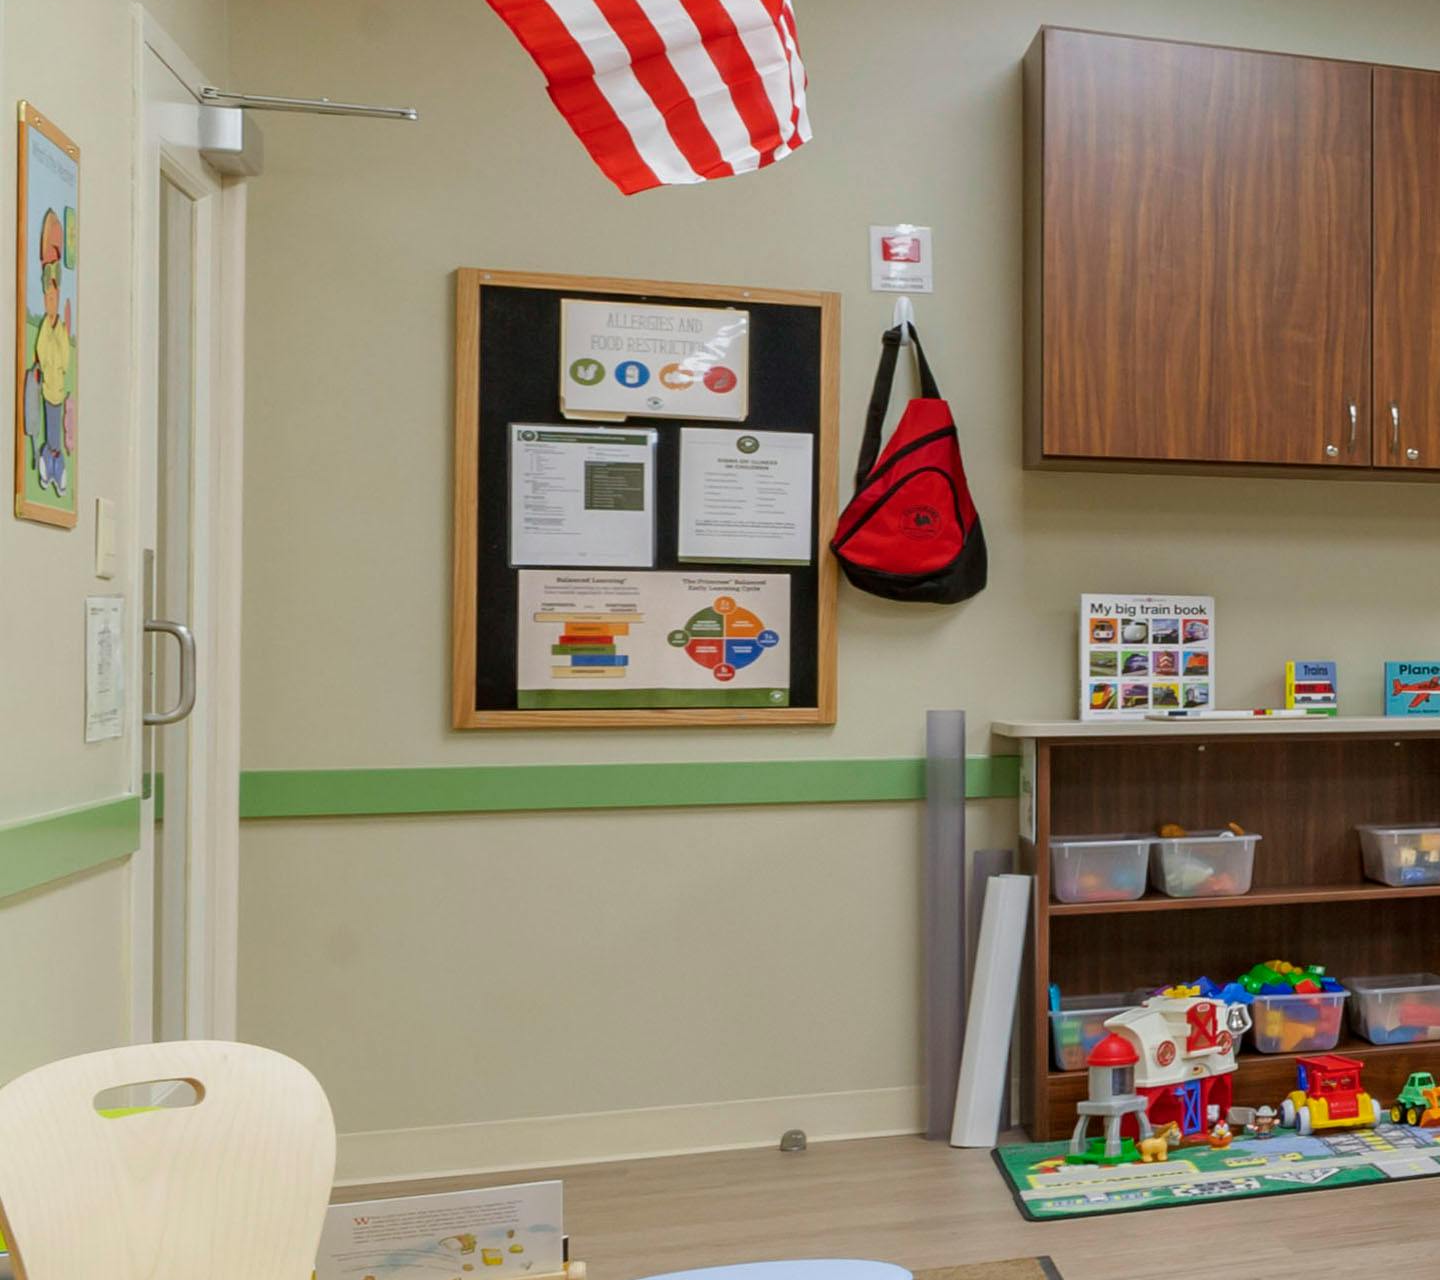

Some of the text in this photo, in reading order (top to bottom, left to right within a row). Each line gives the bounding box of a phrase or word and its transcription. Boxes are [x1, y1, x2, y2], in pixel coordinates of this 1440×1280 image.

[606, 312, 703, 333] ALLERGIES AND
[591, 335, 624, 351] FOOD
[1090, 603, 1207, 617] My big train book
[1303, 664, 1329, 676] Trains
